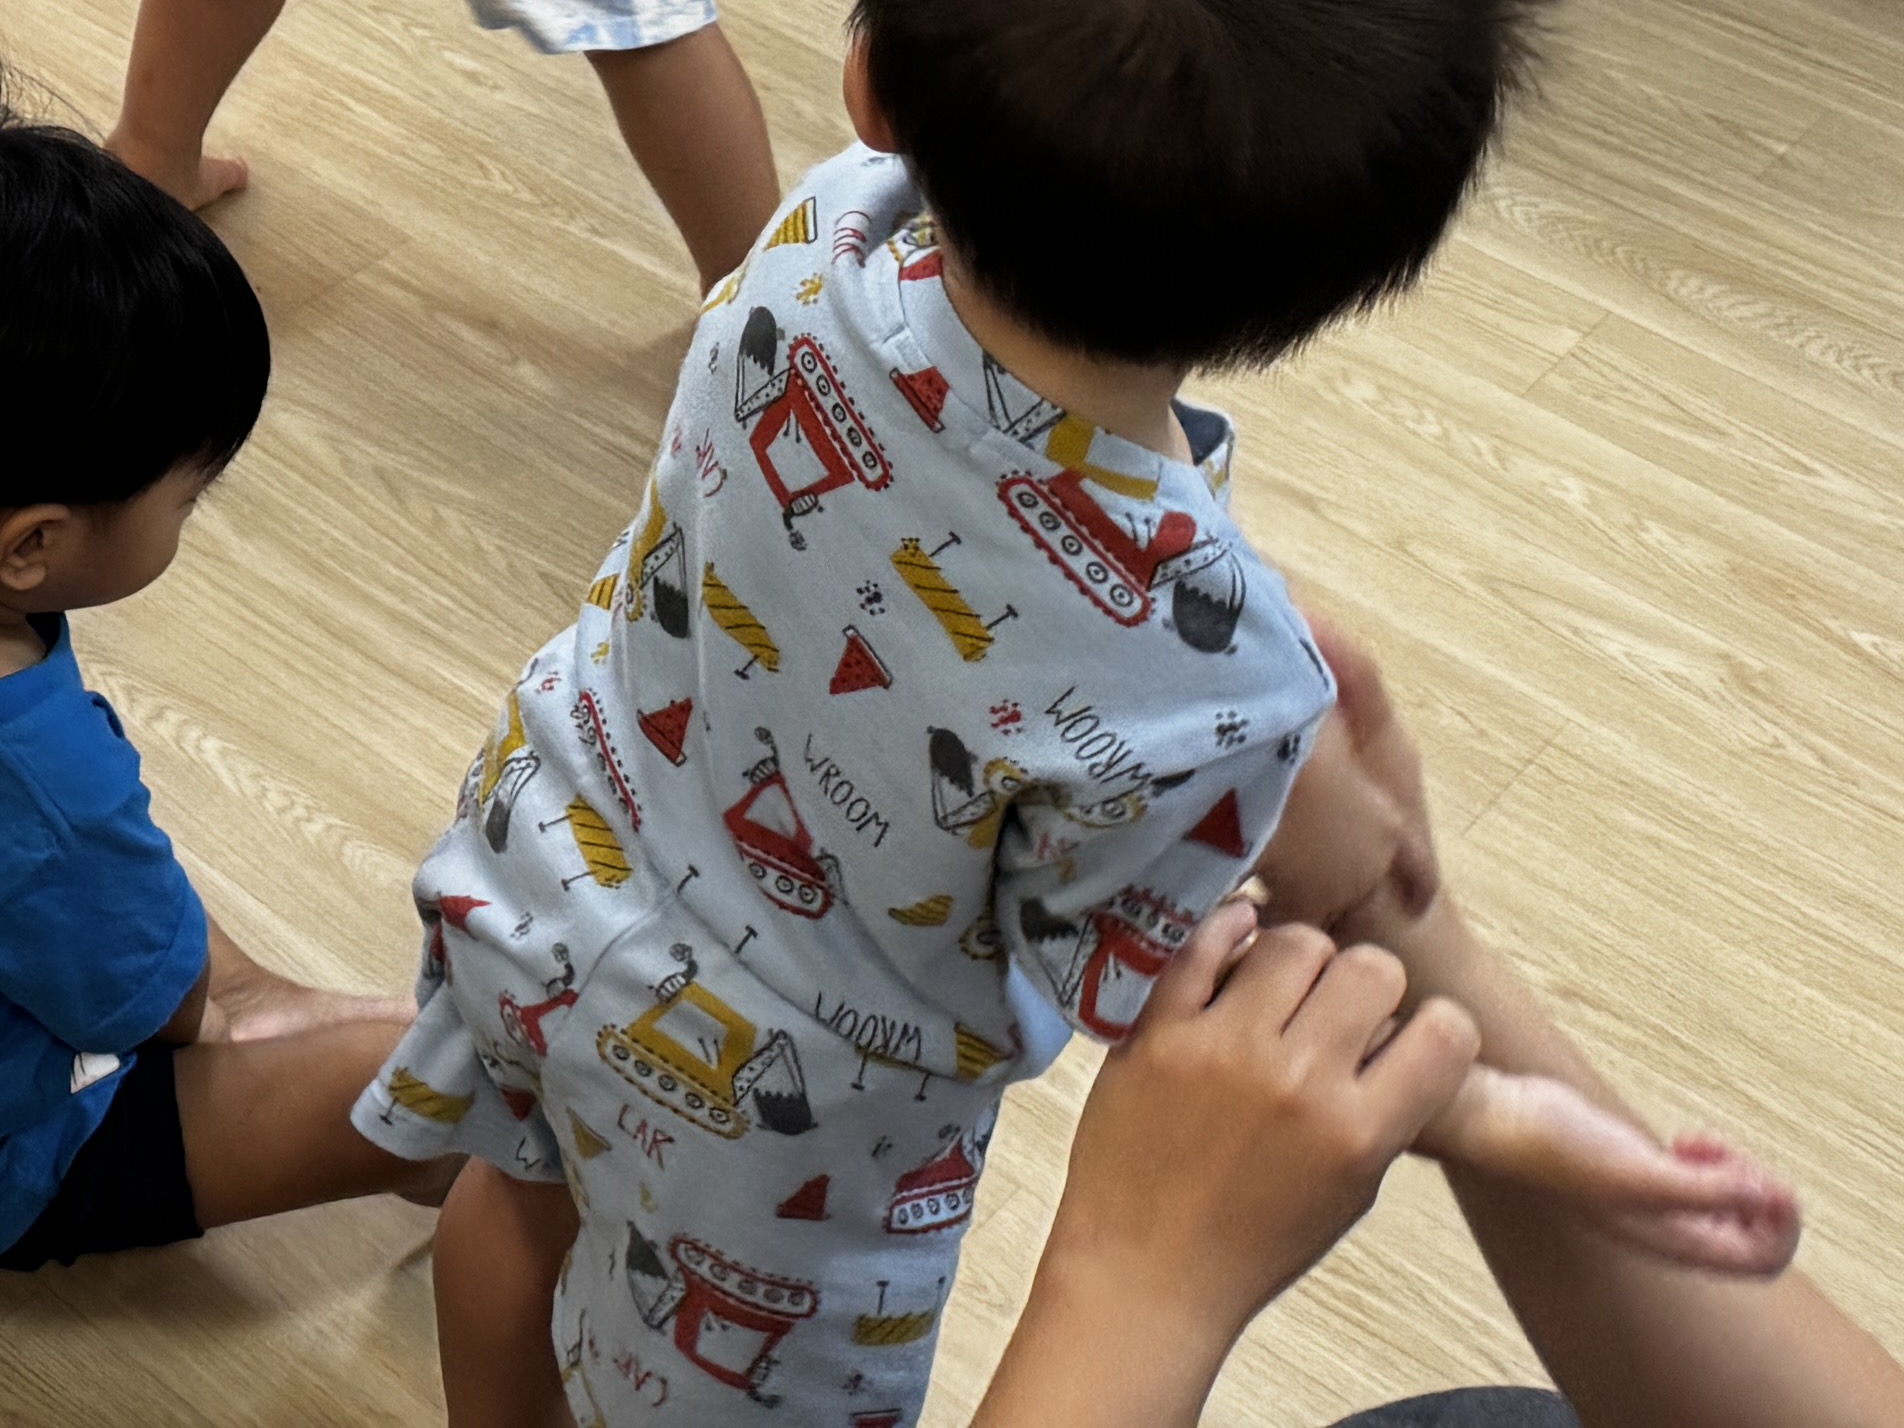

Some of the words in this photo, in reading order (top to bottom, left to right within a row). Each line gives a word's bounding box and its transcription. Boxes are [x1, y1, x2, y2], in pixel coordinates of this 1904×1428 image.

[803, 732, 891, 849] WROOM
[1044, 685, 1155, 800] WROOM
[813, 990, 924, 1066] WROOM
